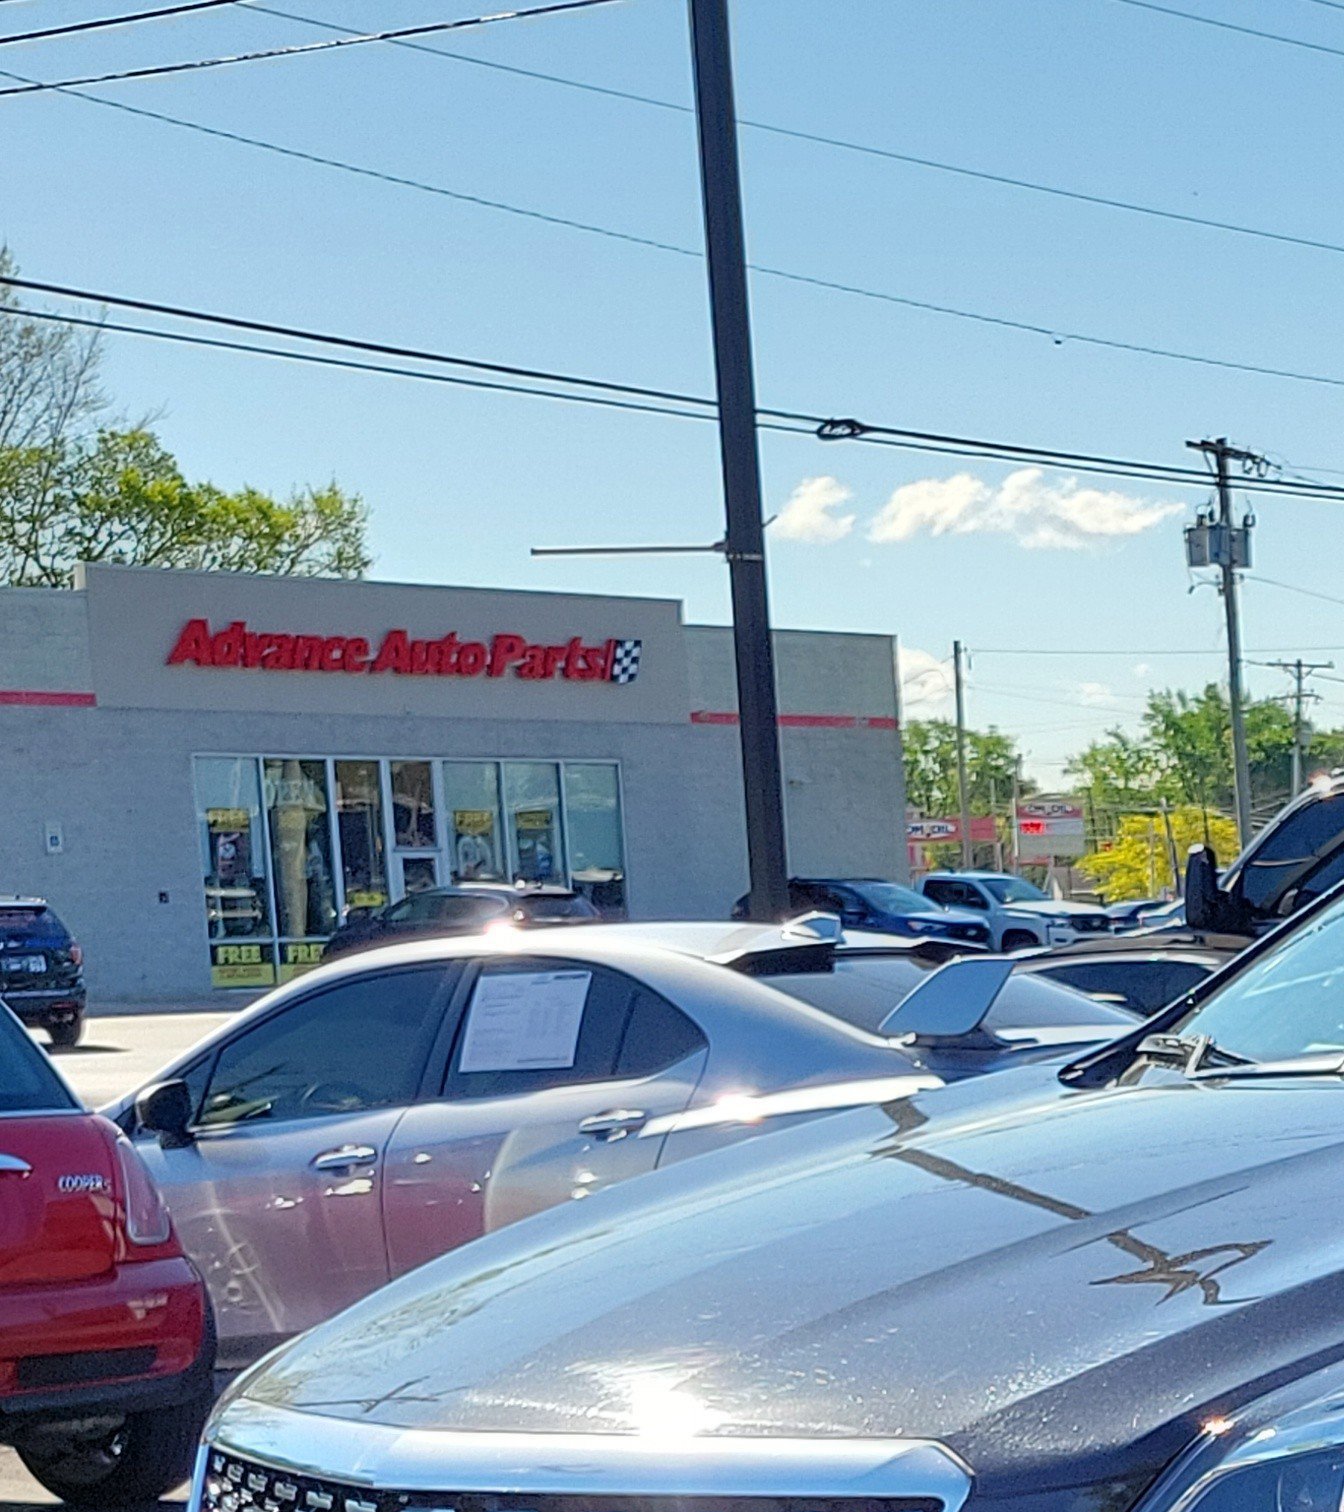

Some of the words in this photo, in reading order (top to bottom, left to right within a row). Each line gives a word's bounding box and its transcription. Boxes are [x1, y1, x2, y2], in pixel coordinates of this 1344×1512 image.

[167, 618, 370, 675] Advance
[370, 630, 486, 677] Auto
[217, 945, 261, 964] FREE
[58, 1174, 102, 1192] COOPER
